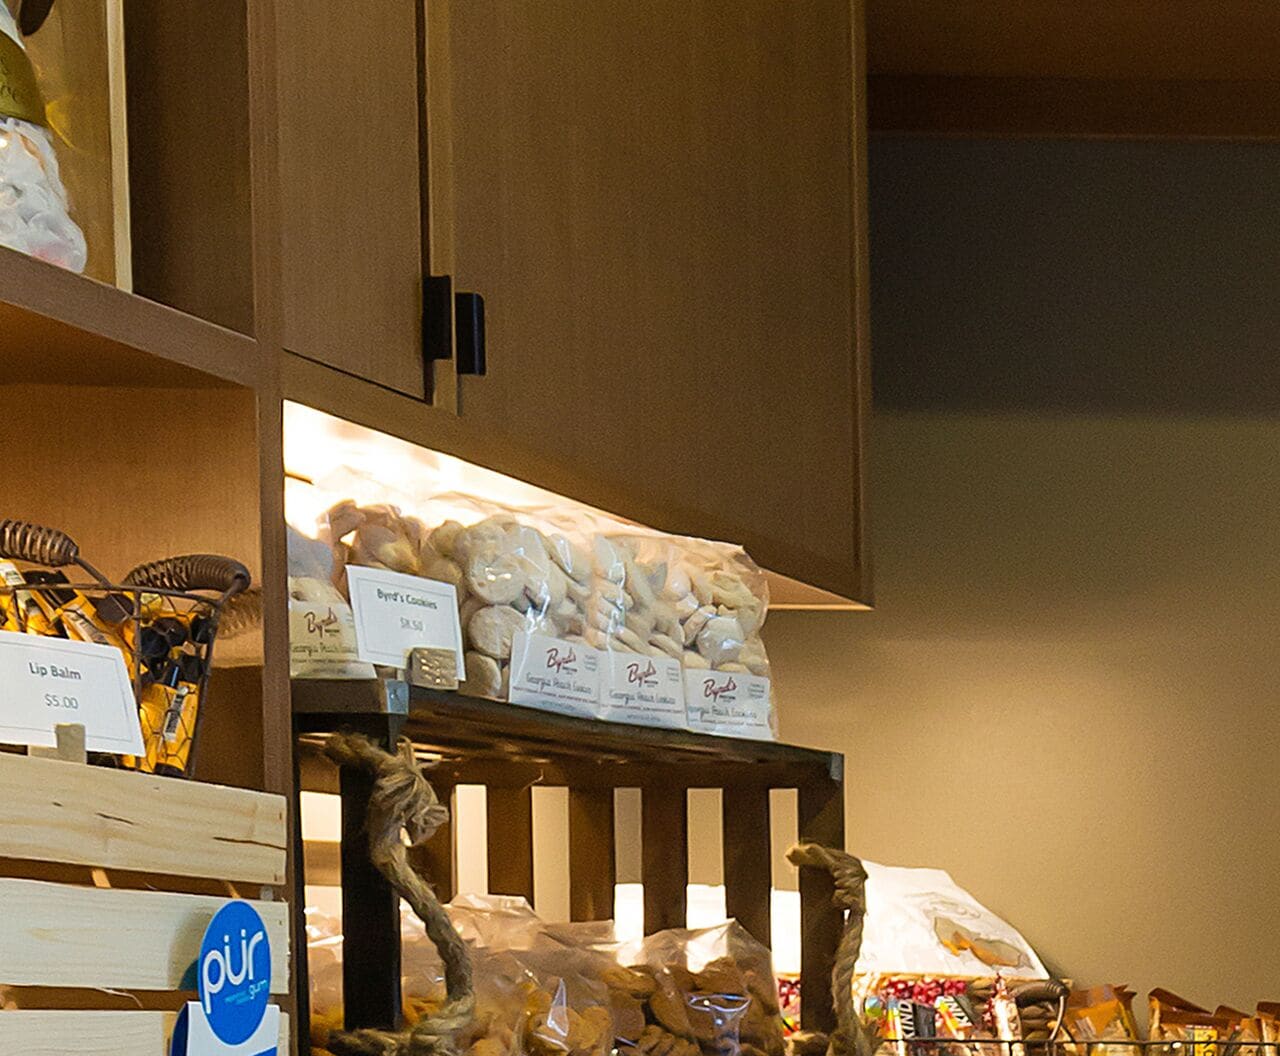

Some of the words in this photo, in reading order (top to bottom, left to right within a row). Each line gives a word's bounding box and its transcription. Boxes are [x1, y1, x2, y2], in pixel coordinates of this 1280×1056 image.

[376, 587, 405, 603] Byrd's
[406, 593, 438, 610] Cookies
[28, 661, 48, 679] Lip
[50, 664, 82, 681] Balm
[44, 693, 79, 710] $5.00
[900, 999, 915, 1040] KIND
